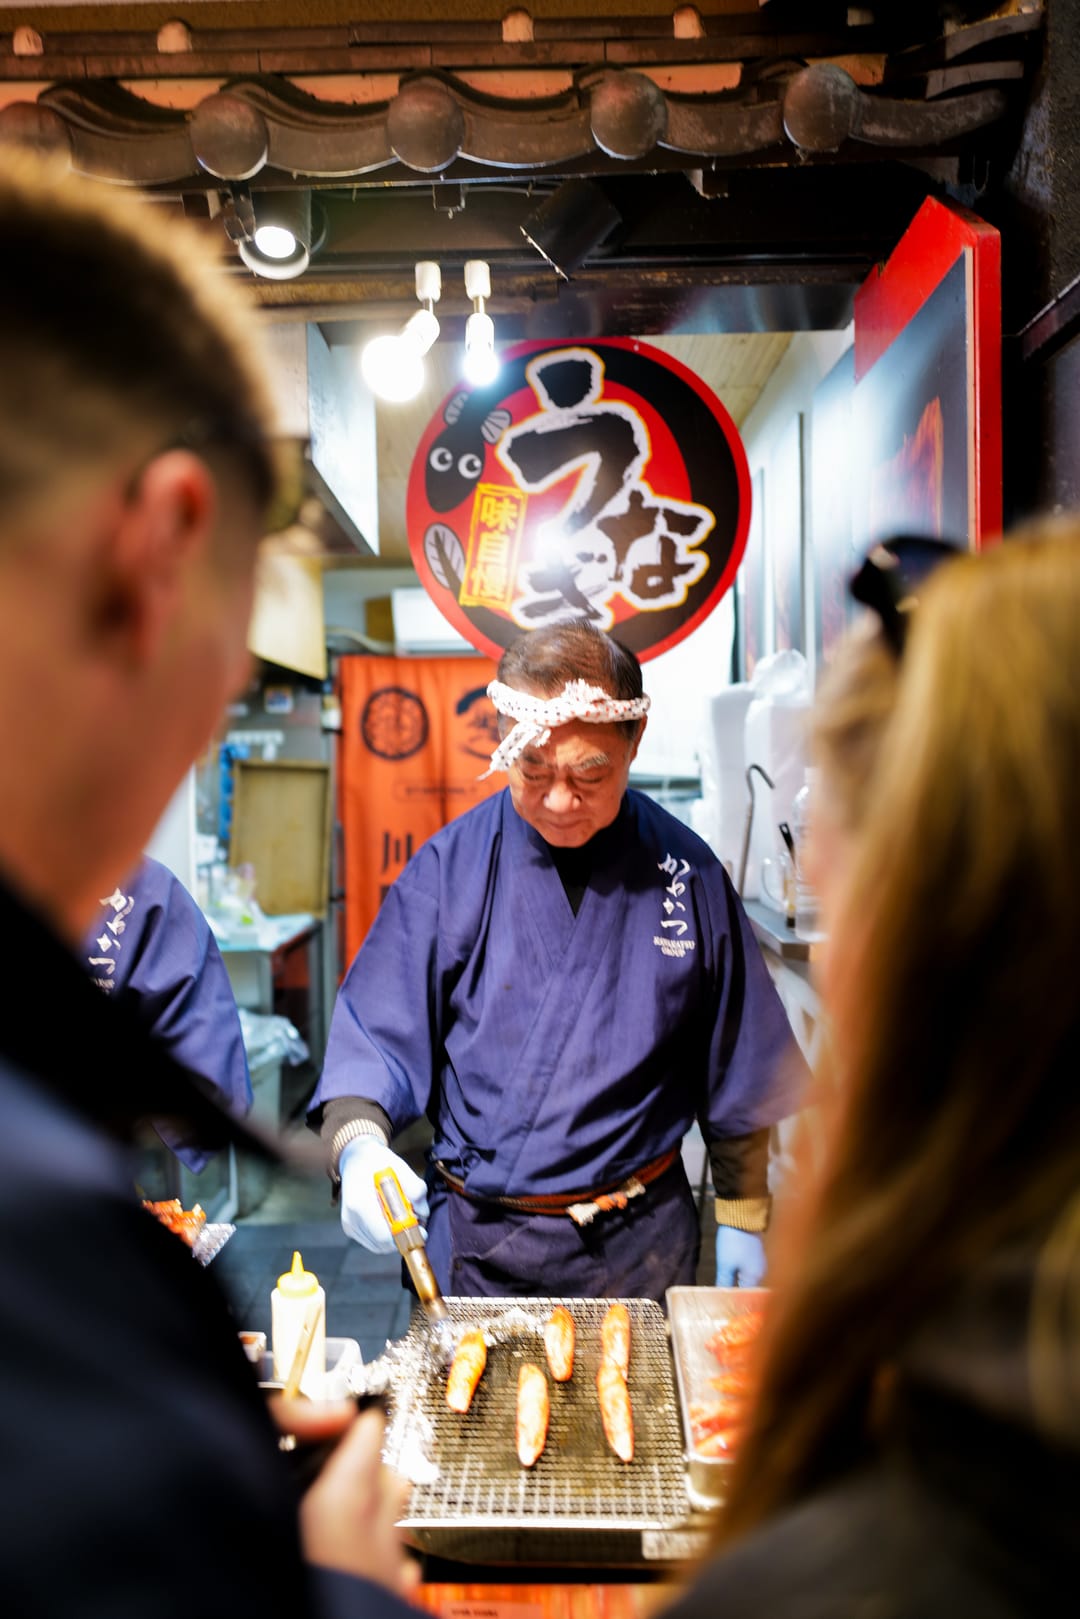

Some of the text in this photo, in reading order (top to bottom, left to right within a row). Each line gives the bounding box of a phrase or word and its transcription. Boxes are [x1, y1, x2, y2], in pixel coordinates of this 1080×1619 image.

[470, 495, 519, 601] 味自慢
[497, 348, 714, 628] うなぎ
